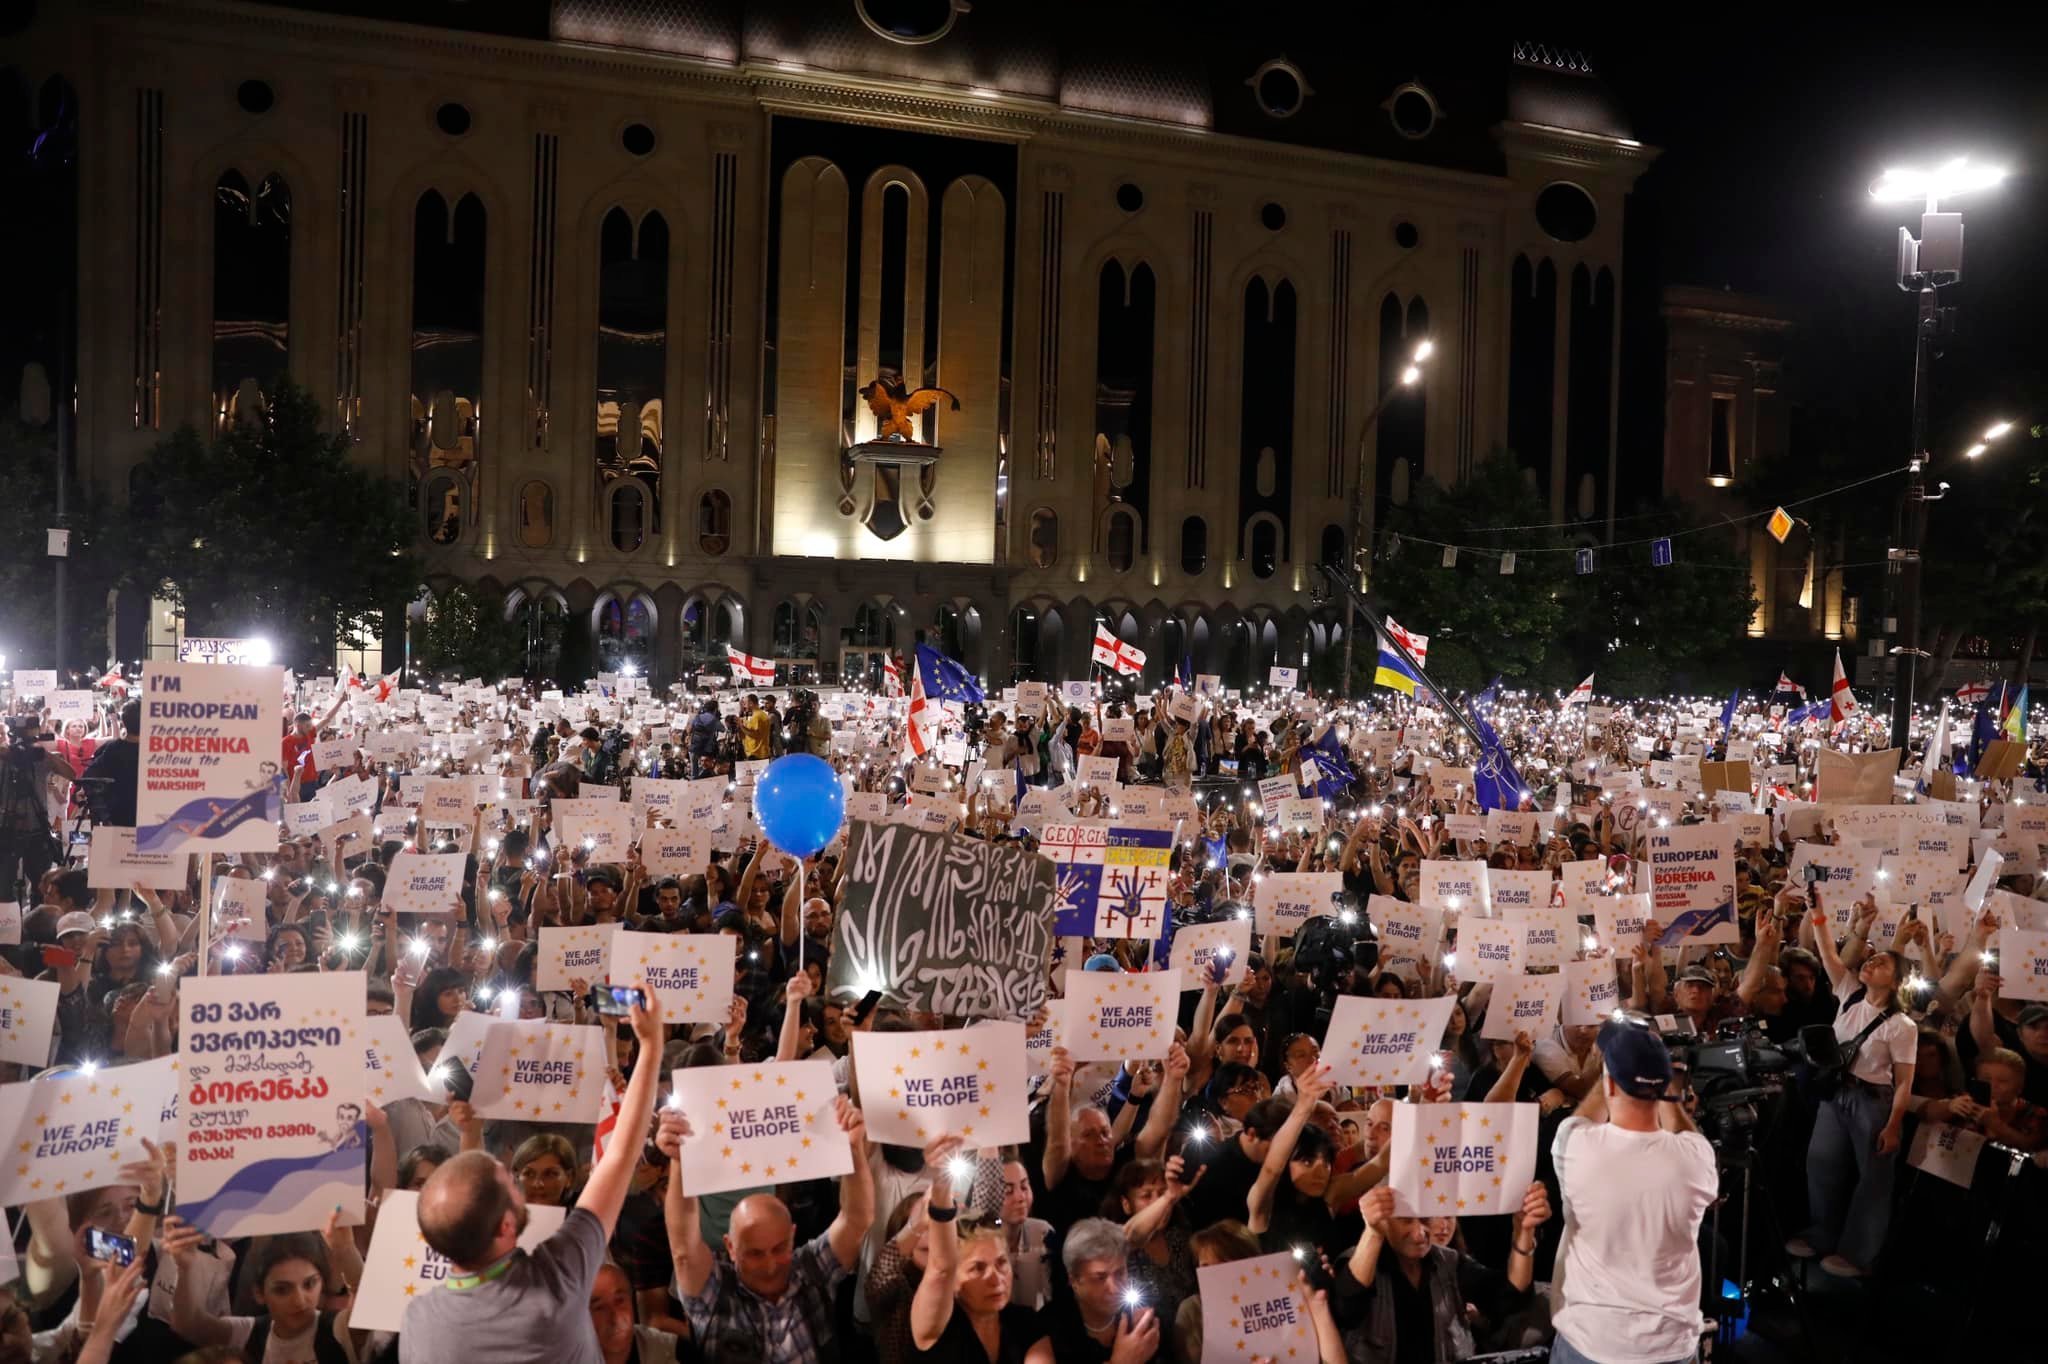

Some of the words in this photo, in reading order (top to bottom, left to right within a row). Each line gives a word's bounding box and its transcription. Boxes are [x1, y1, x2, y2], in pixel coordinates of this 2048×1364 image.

[151, 675, 181, 692] I'M
[150, 702, 258, 720] EUROPEAN
[151, 725, 219, 736] Therefore
[149, 736, 250, 753] BORENKA
[200, 755, 220, 766] the
[148, 768, 199, 778] RUSSIAN
[147, 781, 205, 791] WARSHIP!
[1045, 826, 1107, 844] GEORGIA
[1120, 837, 1140, 847] THE
[1652, 837, 1670, 848] I'M
[1653, 850, 1718, 863] EUROPEAN
[1655, 871, 1716, 884] BORENKA
[1276, 909, 1308, 918] EUROPE
[1388, 920, 1401, 929] WE
[1404, 925, 1421, 933] ARE
[1386, 928, 1420, 940] EUROPE
[1194, 949, 1208, 957] WE
[1478, 951, 1510, 960] EUROPE
[565, 957, 600, 966] EUROPE
[647, 968, 666, 978] WE
[672, 968, 697, 978] ARE
[1590, 984, 1605, 993] WE
[1516, 1001, 1529, 1009] WE
[1531, 1000, 1544, 1008] ARE
[190, 1003, 222, 1024] მე
[228, 1001, 281, 1022] ვარ
[1102, 1007, 1122, 1016] WE
[1126, 1007, 1152, 1016] ARE
[1514, 1009, 1543, 1017] EUROPE
[1100, 1018, 1152, 1028] EUROPE
[190, 1027, 341, 1053] ევროპელი
[1026, 1039, 1052, 1049] ROPE
[1366, 1034, 1387, 1044] WE
[1390, 1032, 1416, 1043] ARE
[1362, 1043, 1413, 1054] EUROPE
[517, 1060, 540, 1072] WE
[543, 1062, 573, 1072] ARE
[190, 1066, 210, 1082] და
[514, 1072, 572, 1084] EUROPE
[905, 1080, 933, 1092] WE
[941, 1074, 978, 1091] ARE
[189, 1076, 329, 1106] ბორენკა
[906, 1089, 979, 1107] EUROPE
[728, 1110, 756, 1124] WE
[763, 1105, 797, 1120] ARE
[44, 1126, 74, 1142] WE
[80, 1119, 120, 1137] ARE
[188, 1126, 263, 1143] რუსული
[267, 1124, 316, 1138] გემის
[730, 1120, 800, 1140] EUROPE
[36, 1135, 117, 1158] EUROPE
[1435, 1146, 1456, 1159] WE
[1462, 1146, 1493, 1158] ARE
[188, 1147, 234, 1162] გზას!
[1434, 1160, 1494, 1173] EUROPE
[1241, 1302, 1266, 1320] WE
[1269, 1297, 1290, 1316] ARE
[1244, 1312, 1296, 1334] EUROPE
